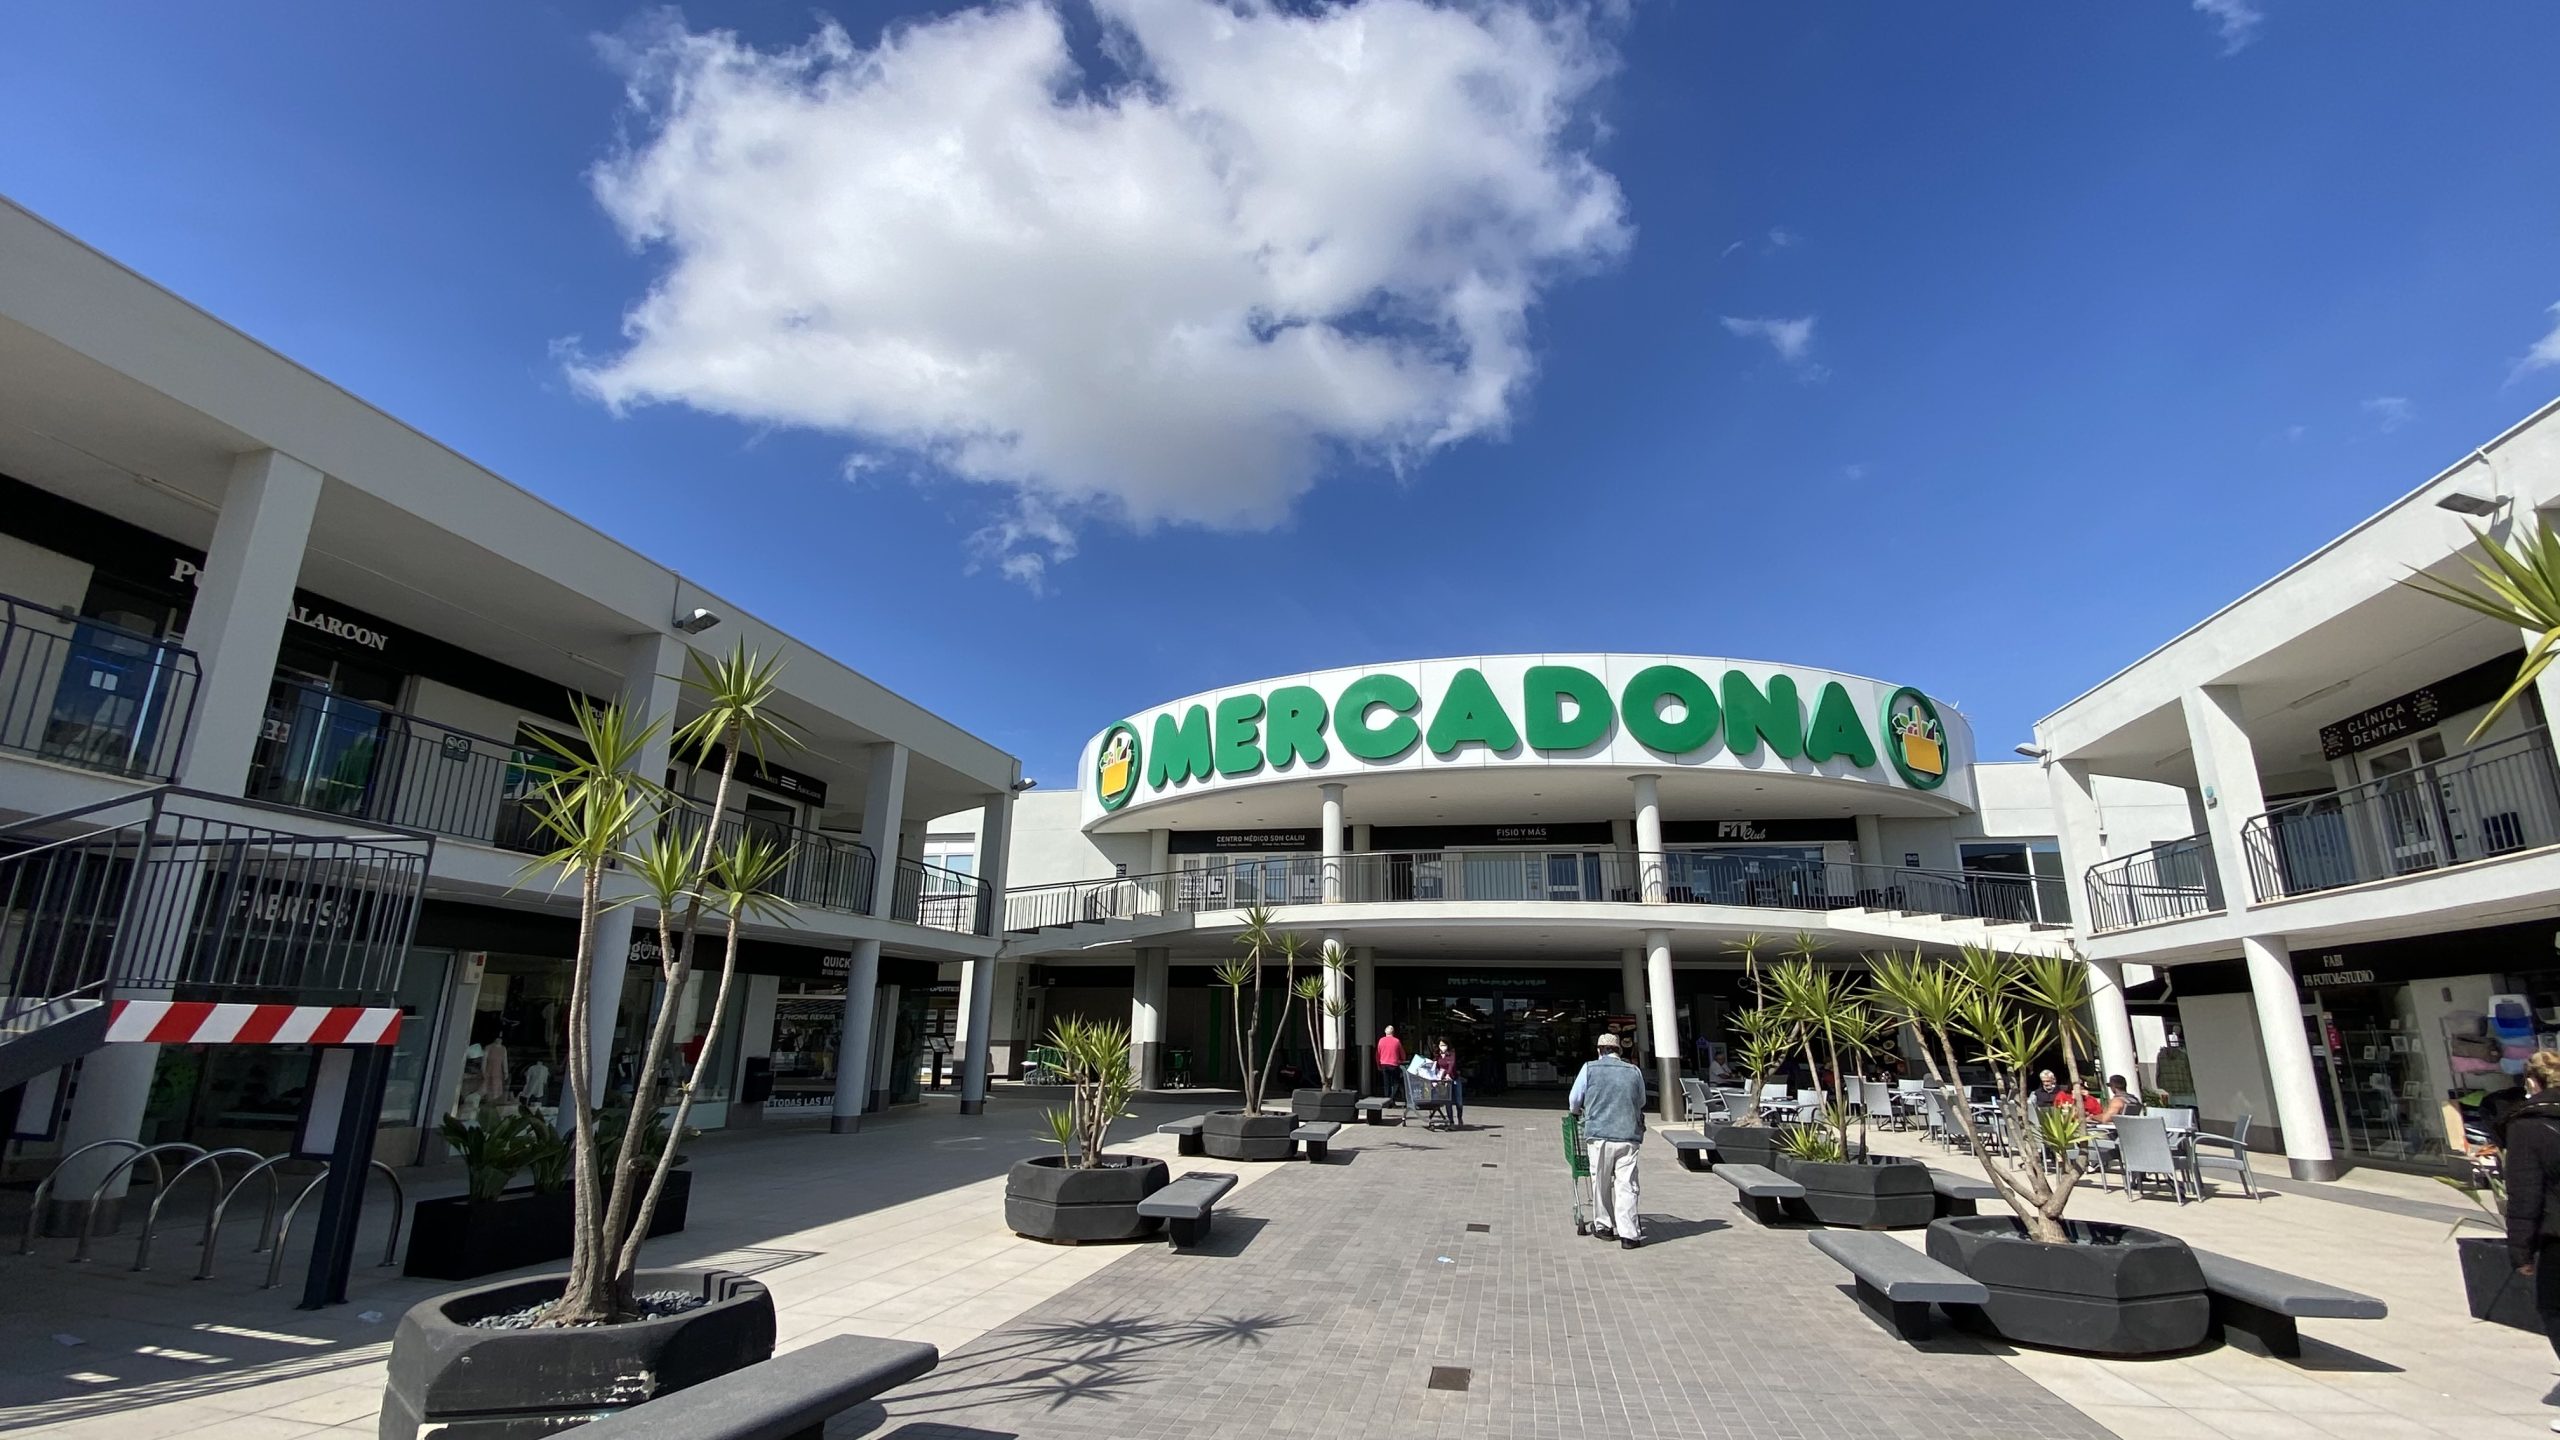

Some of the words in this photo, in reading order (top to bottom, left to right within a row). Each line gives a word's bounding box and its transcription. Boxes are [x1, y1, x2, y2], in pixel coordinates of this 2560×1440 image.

[2347, 703, 2406, 733] CLÍNICA
[1146, 664, 1877, 791] MERCADONA
[2352, 719, 2408, 746] DENTAL
[1216, 835, 1242, 843] CENTRO
[1243, 834, 1268, 842] MÉDICO
[1270, 834, 1284, 842] SON
[1496, 828, 1519, 836] FISIO
[1520, 828, 1526, 836] Y
[823, 955, 852, 969] QUICK
[774, 1098, 802, 1107] TODAS
[804, 1097, 821, 1106] LAS
